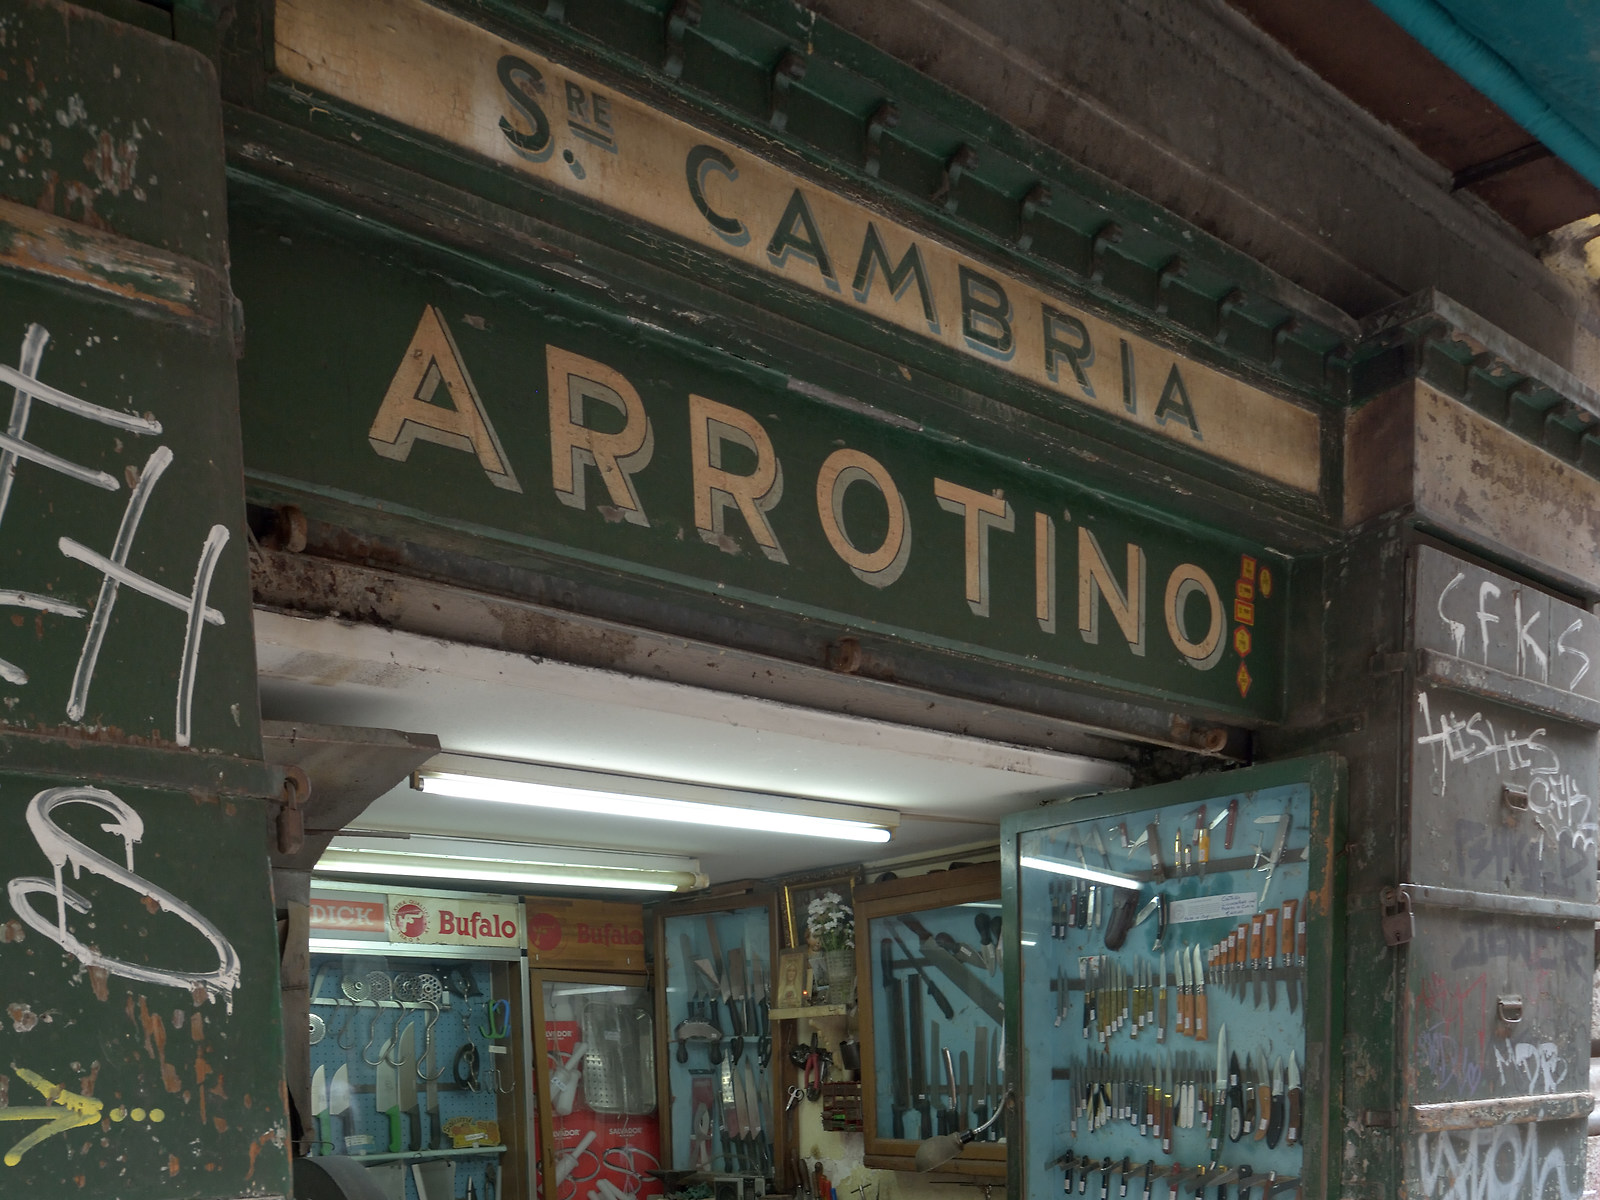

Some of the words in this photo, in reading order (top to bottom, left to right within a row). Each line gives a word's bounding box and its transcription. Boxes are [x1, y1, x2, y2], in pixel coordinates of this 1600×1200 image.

[685, 144, 1206, 442] CAMBRIA
[368, 303, 1229, 672] ARROTINO
[310, 904, 374, 926] DICK
[438, 909, 517, 939] Bufalo
[576, 922, 644, 948] Bufalo
